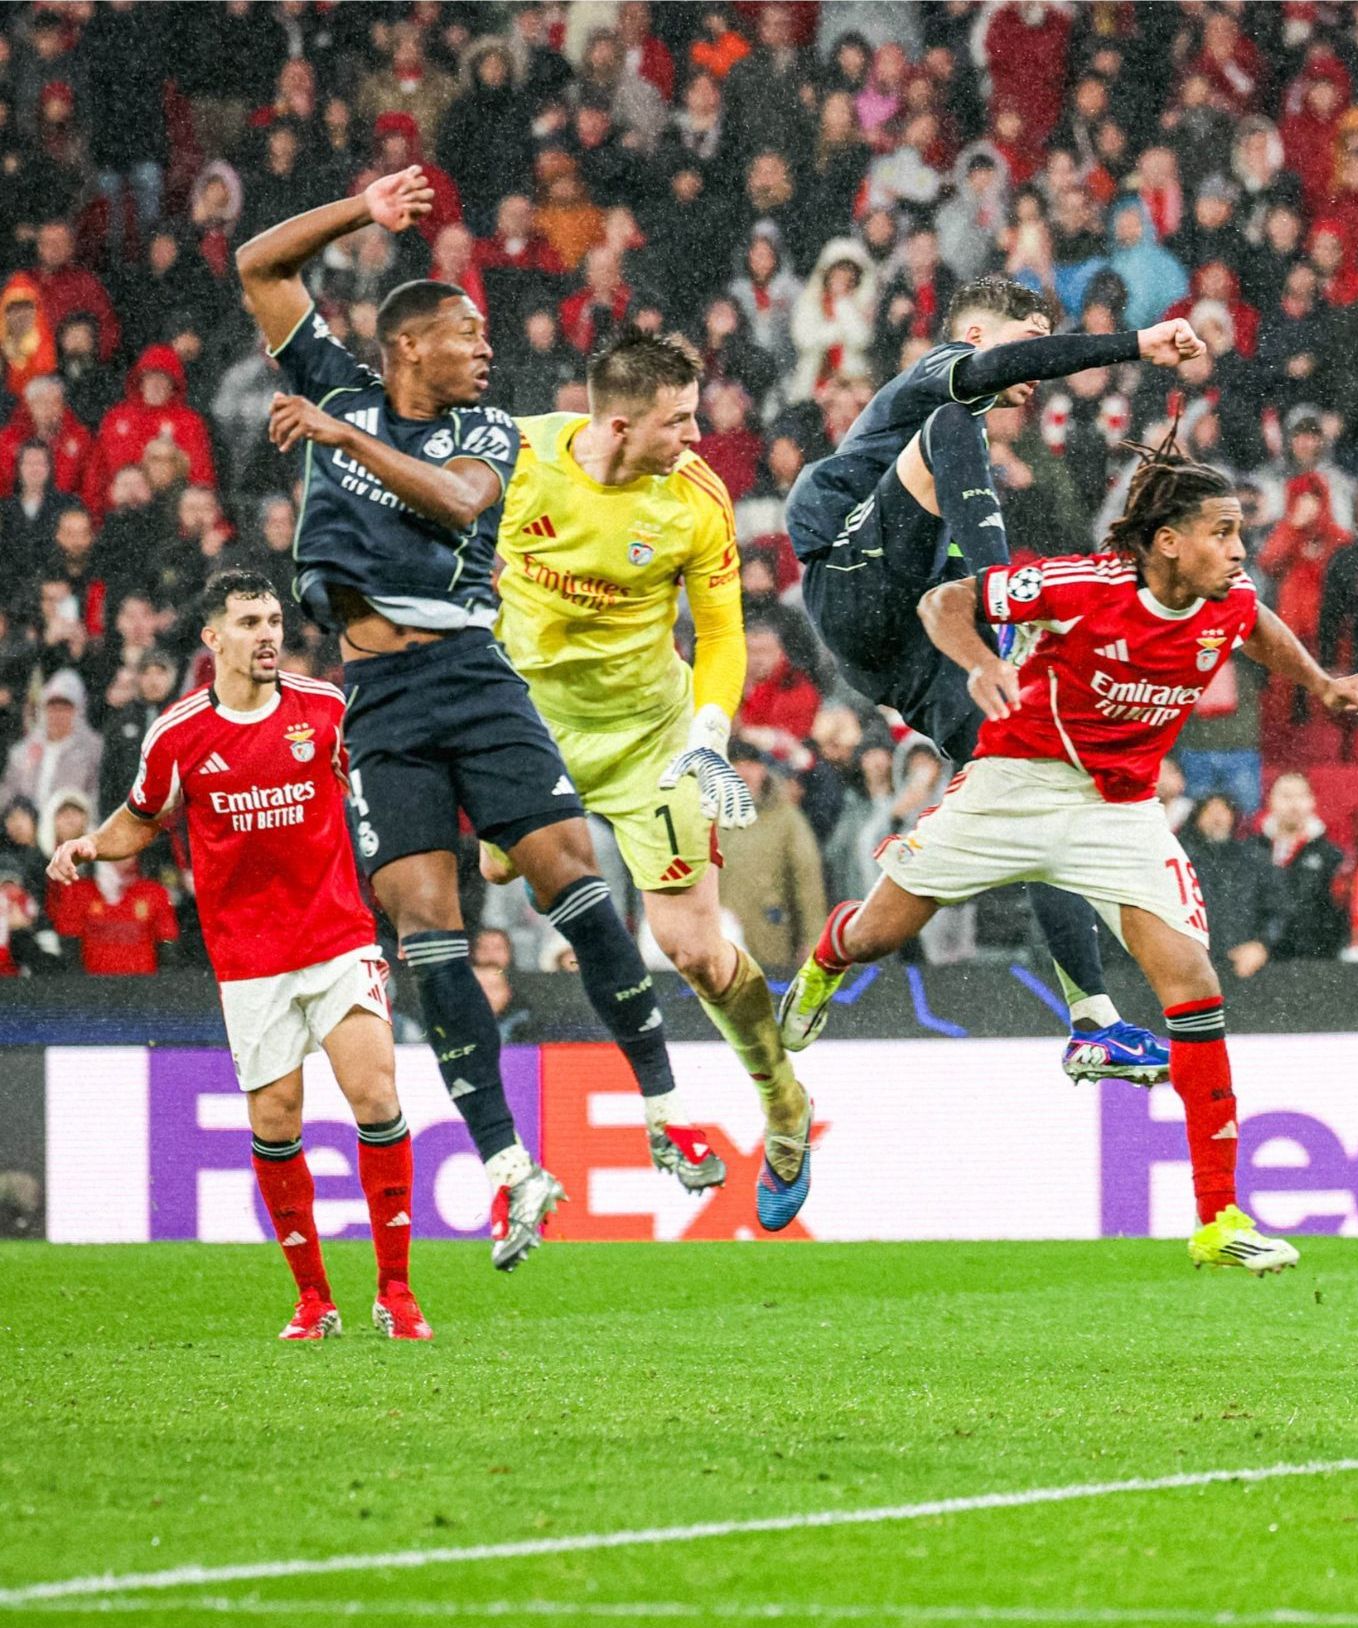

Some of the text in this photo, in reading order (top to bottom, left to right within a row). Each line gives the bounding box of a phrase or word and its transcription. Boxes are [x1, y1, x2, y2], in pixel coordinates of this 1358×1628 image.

[1090, 669, 1204, 706] Emirates
[209, 780, 316, 814] Emirates
[232, 804, 305, 832] FLY BETTER
[655, 804, 679, 856] 1
